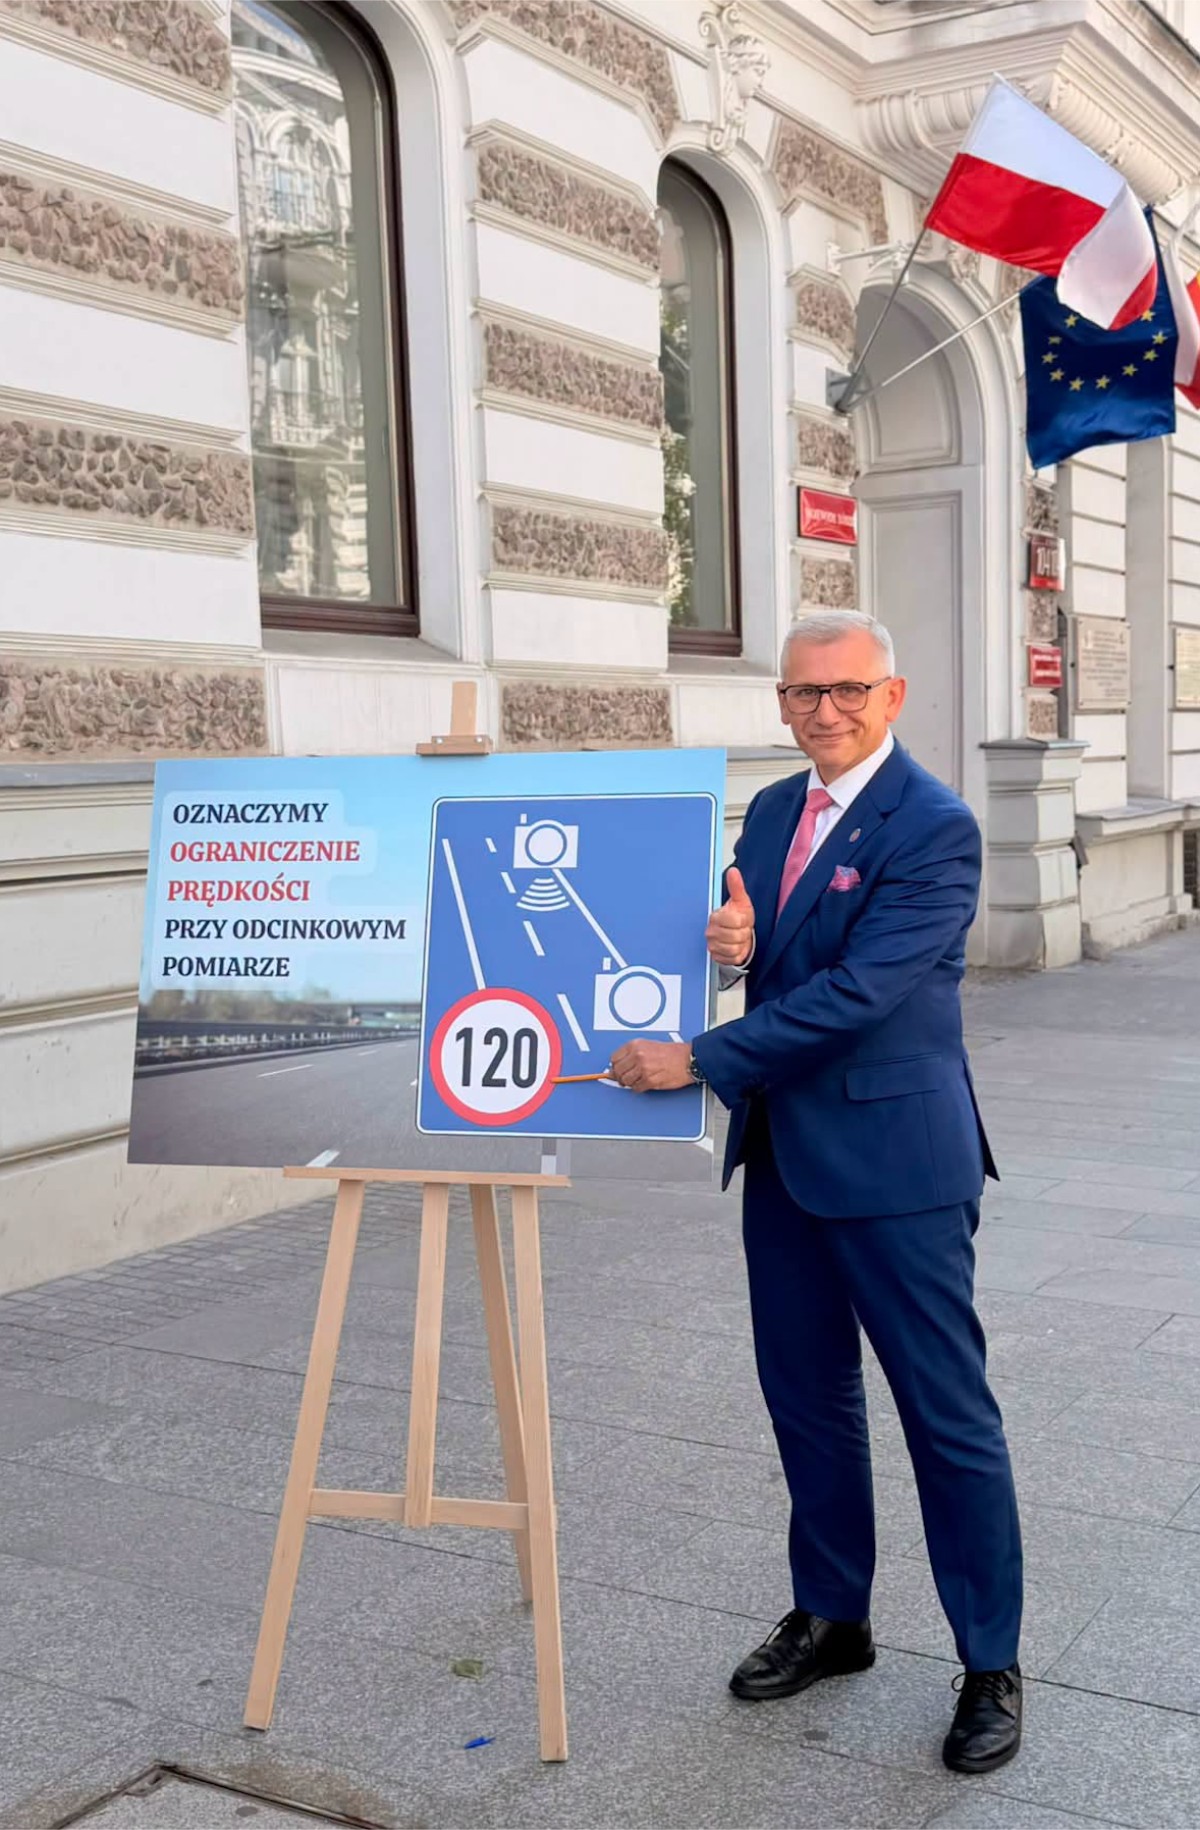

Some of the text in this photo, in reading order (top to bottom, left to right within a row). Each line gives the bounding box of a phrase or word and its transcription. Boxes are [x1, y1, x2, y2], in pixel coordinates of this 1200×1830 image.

[173, 803, 329, 824] OZNACZYMY
[170, 840, 360, 862] OGRANICZENIE
[167, 872, 310, 907] PRĘDKOŚCI
[164, 919, 406, 940] PRZY ODCINKOWYM
[162, 956, 290, 977] POMIARZE
[455, 1027, 538, 1088] 120
